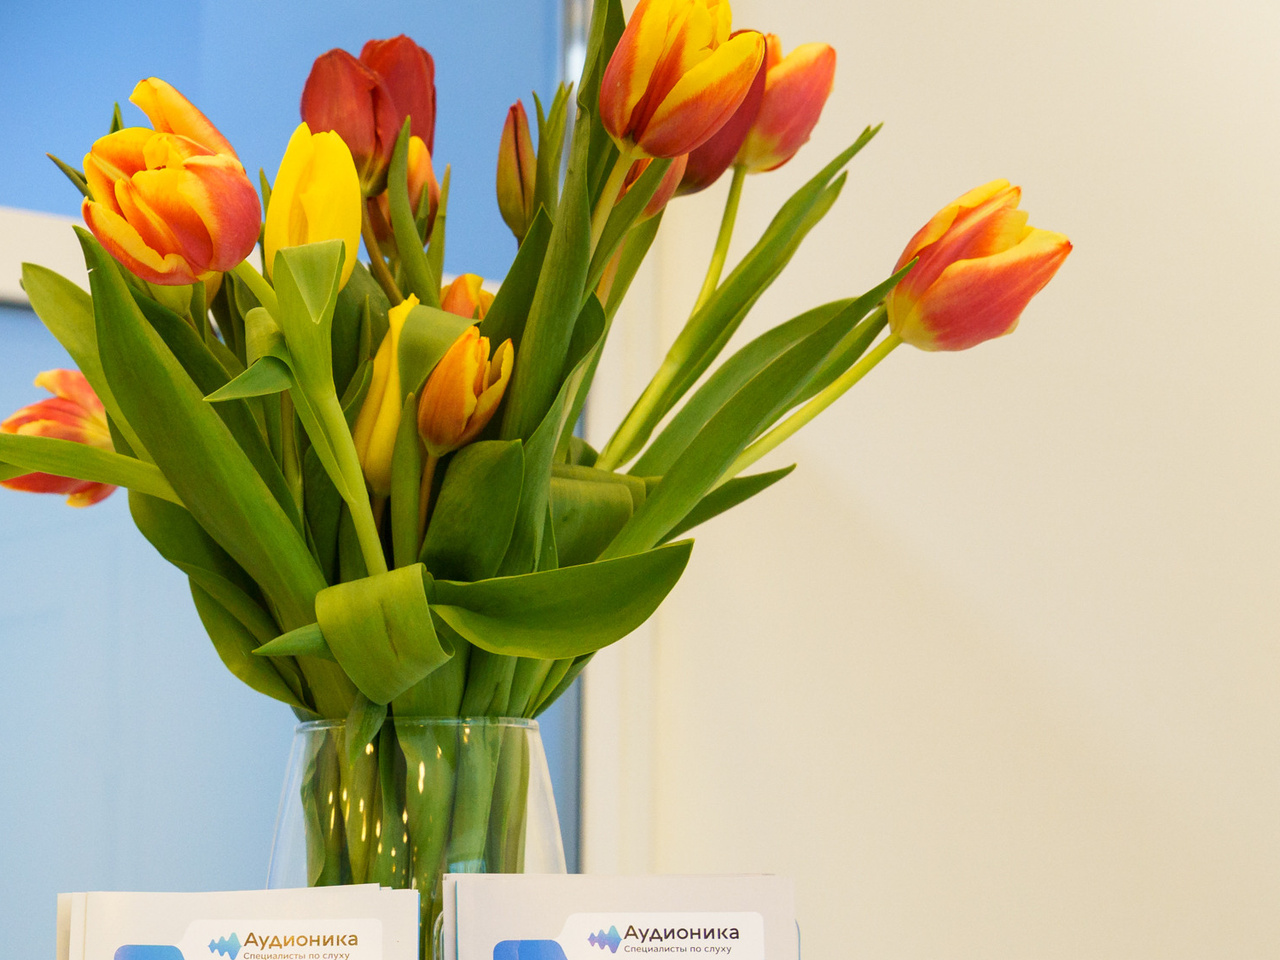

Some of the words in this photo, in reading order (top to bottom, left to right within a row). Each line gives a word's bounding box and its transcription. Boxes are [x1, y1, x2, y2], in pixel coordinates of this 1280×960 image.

[243, 931, 359, 950] Аудионика
[623, 925, 740, 943] Аудионика
[243, 951, 306, 960] Специалисты
[308, 952, 320, 960] по
[322, 951, 350, 960] слуху
[624, 945, 687, 954] Специалисты
[704, 945, 732, 954] слуху
